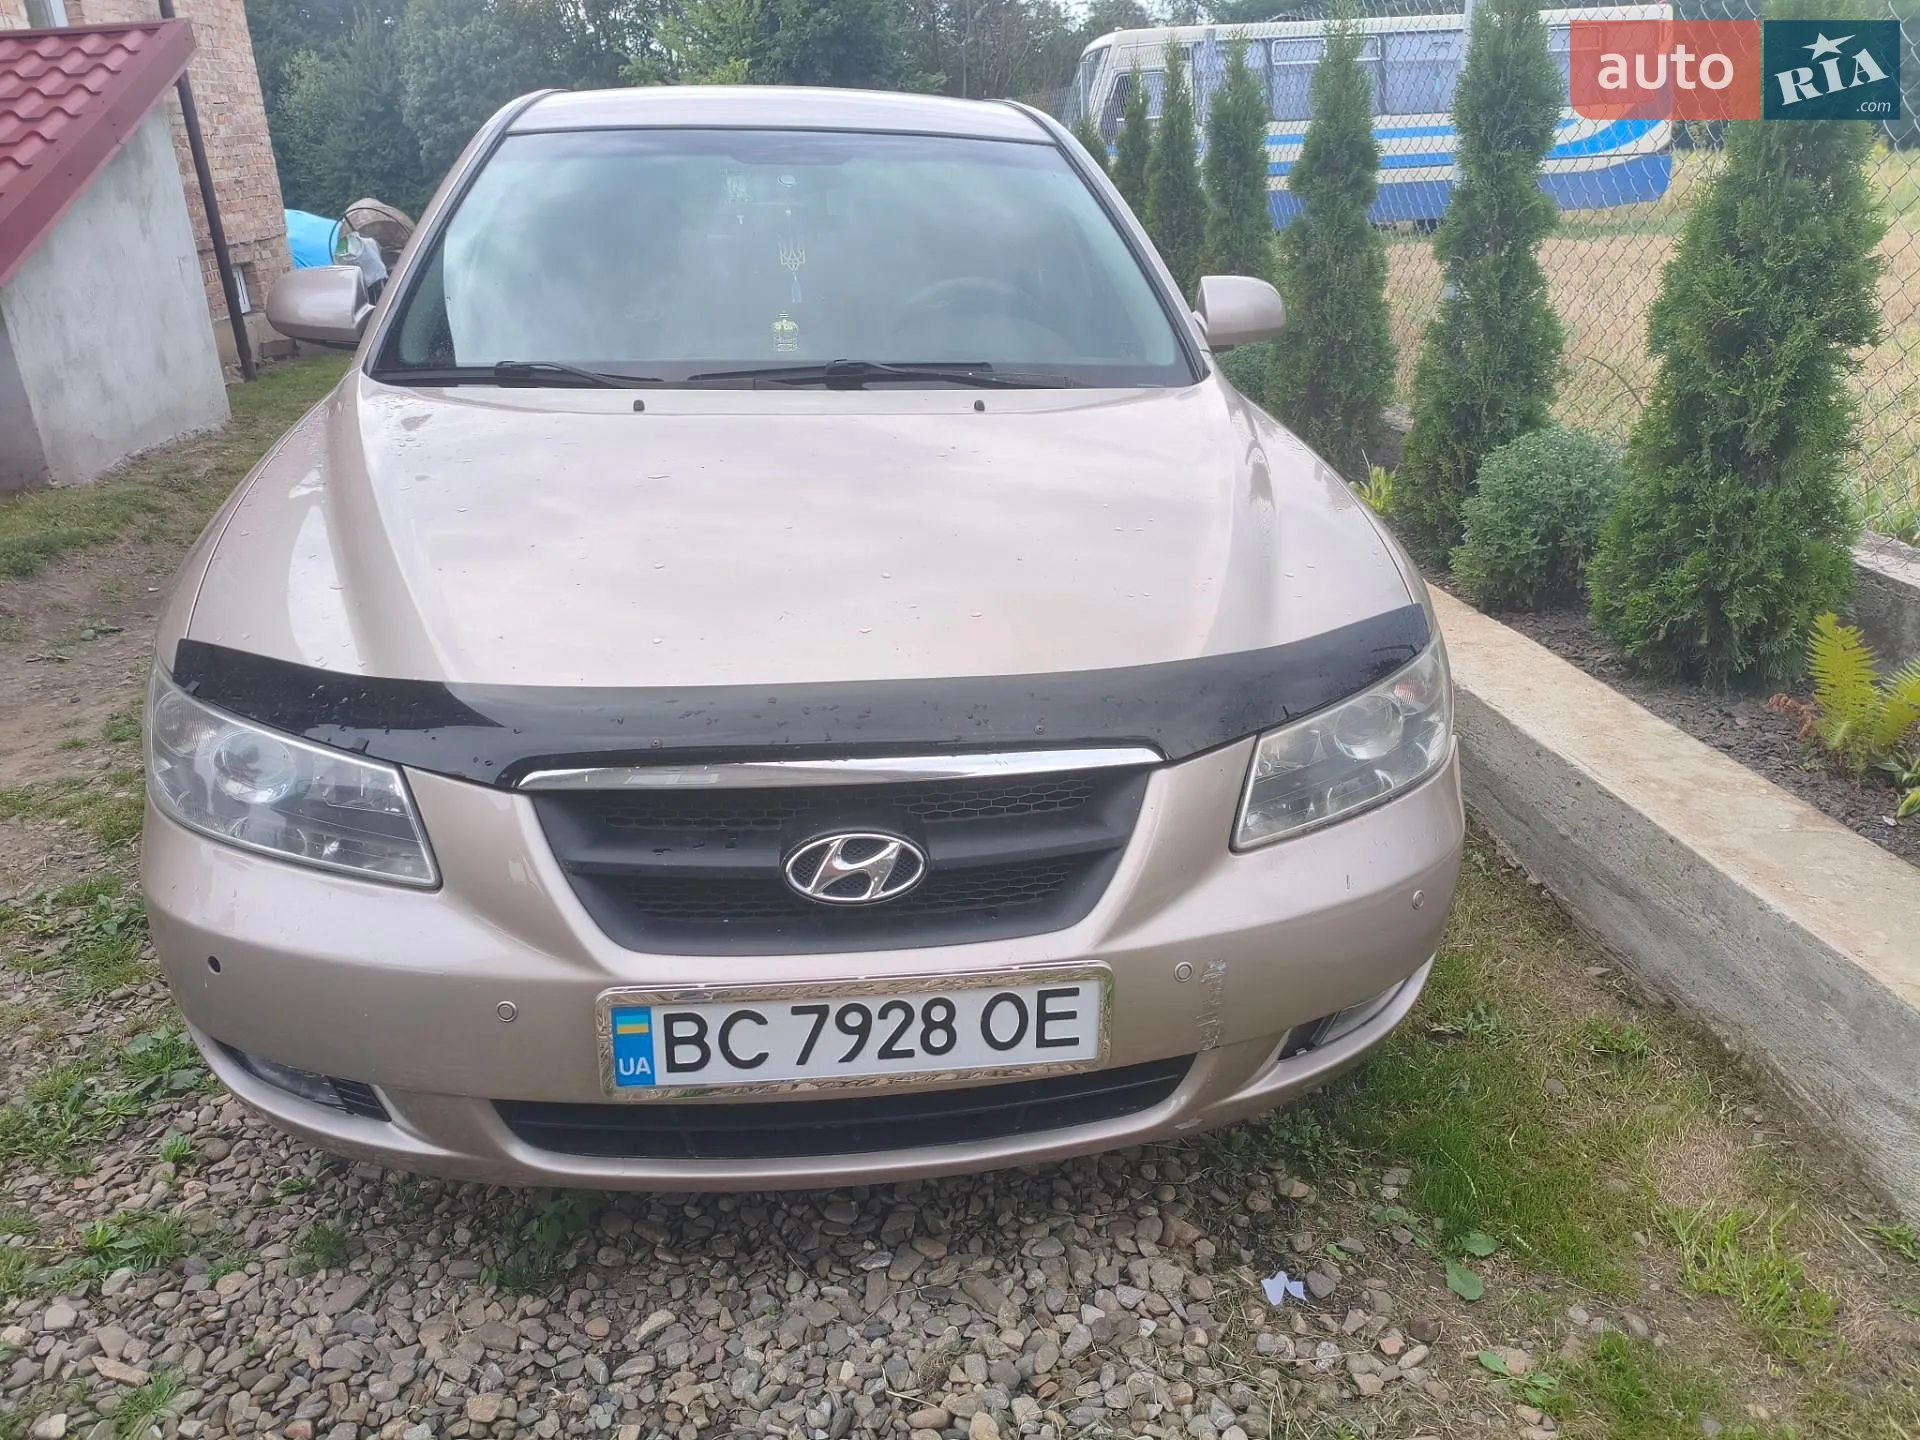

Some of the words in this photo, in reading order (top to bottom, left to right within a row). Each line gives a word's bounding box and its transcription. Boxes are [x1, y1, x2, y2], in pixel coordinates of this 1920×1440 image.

[663, 1008, 770, 1073] BC
[790, 997, 957, 1066] 7928
[980, 986, 1081, 1050] OE
[618, 1055, 651, 1076] UA
